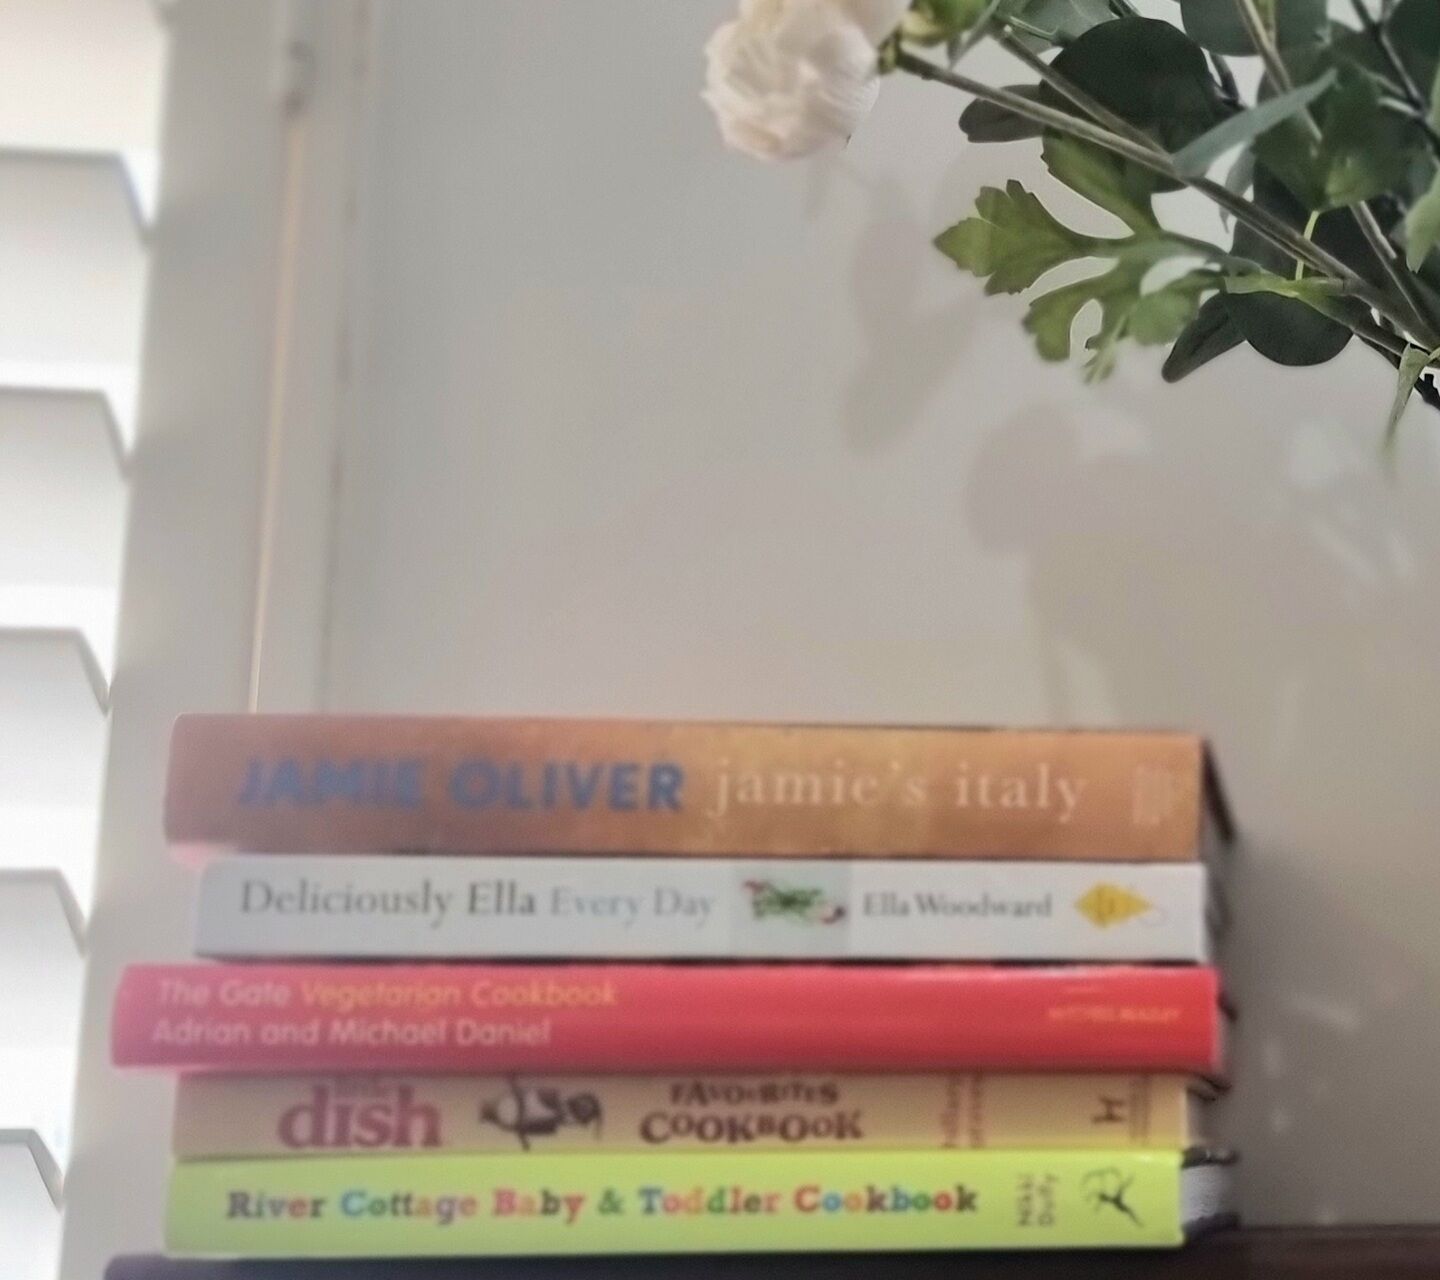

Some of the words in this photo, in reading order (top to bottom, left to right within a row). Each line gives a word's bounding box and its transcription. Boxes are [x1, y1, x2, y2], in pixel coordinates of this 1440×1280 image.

[238, 757, 428, 810] JAMIE
[448, 757, 686, 811] OLIVER
[707, 757, 929, 818] jamie's
[955, 760, 1089, 823] italy
[240, 879, 453, 928] Deliciously
[467, 880, 537, 917] Ella
[550, 884, 642, 927] Every
[653, 886, 716, 926] Day
[862, 891, 908, 918] Ella
[913, 891, 1053, 918] Woodward
[158, 981, 208, 1007] The
[220, 981, 290, 1007] Gate
[301, 981, 461, 1014] Vegetarian
[471, 980, 617, 1008] Cookbook
[153, 1019, 251, 1045] Adrian
[261, 1019, 319, 1045] and
[328, 1019, 446, 1045] Michael
[457, 1019, 552, 1045] Daniel
[278, 1085, 442, 1149] dish
[641, 1110, 864, 1144] COOKBOOK
[227, 1189, 325, 1220] River
[341, 1189, 478, 1225] Cottage
[492, 1189, 586, 1225] Baby
[599, 1190, 625, 1216] &
[640, 1186, 781, 1216] Toddler
[794, 1185, 979, 1214] Cookbook
